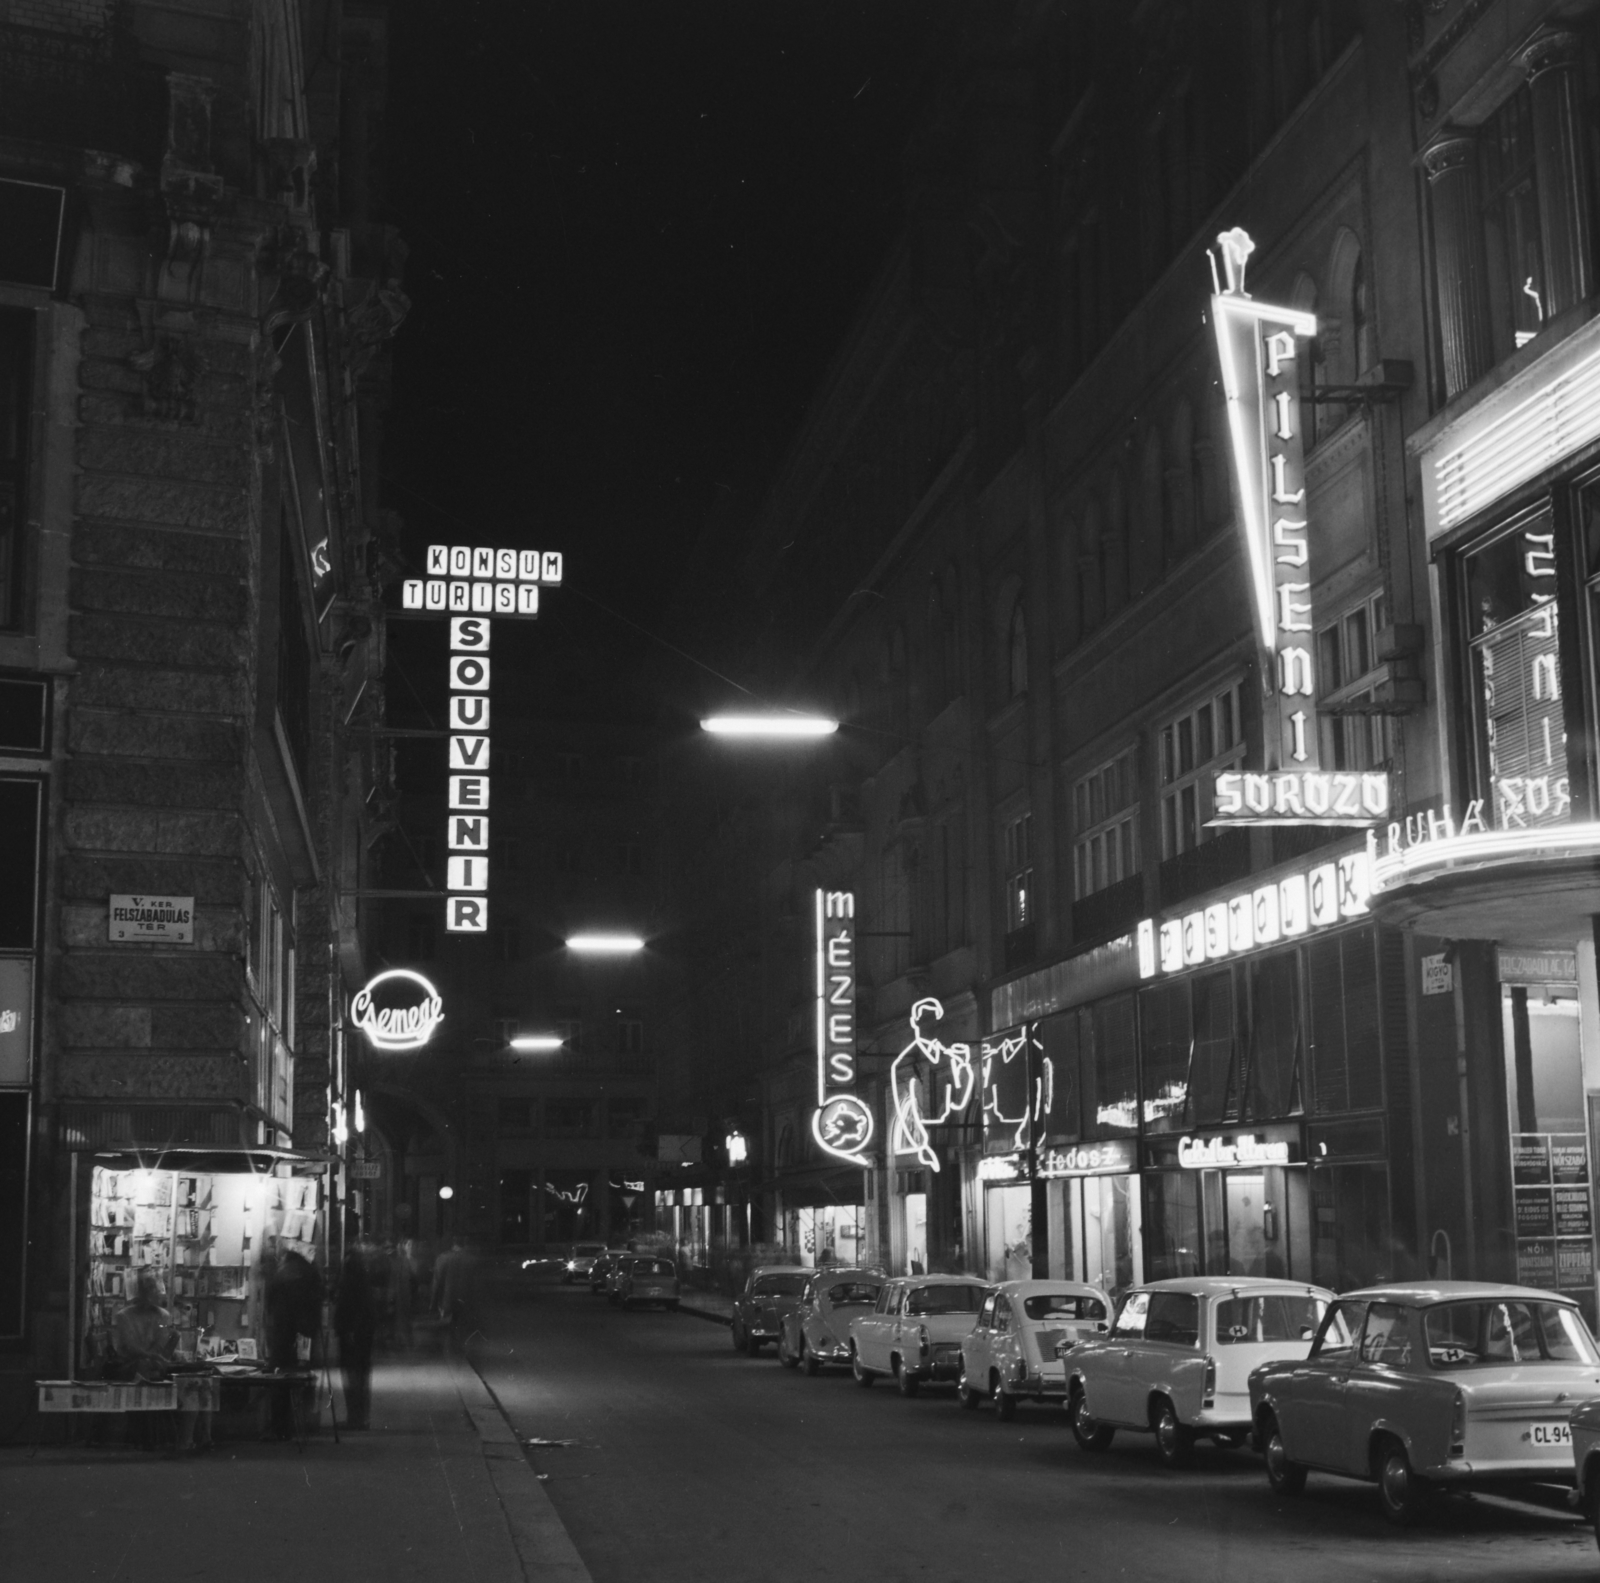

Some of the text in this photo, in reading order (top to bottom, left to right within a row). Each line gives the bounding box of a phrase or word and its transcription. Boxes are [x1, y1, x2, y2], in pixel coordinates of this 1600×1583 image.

[430, 547, 560, 577] KONSUM
[407, 582, 536, 611] TURIST
[453, 618, 487, 929] SOUVENIR
[132, 897, 144, 907] V.
[114, 907, 190, 924] FELSZABADULÁS
[137, 922, 166, 931] TÉR
[350, 989, 446, 1037] Csemege
[1446, 1350, 1460, 1360] H
